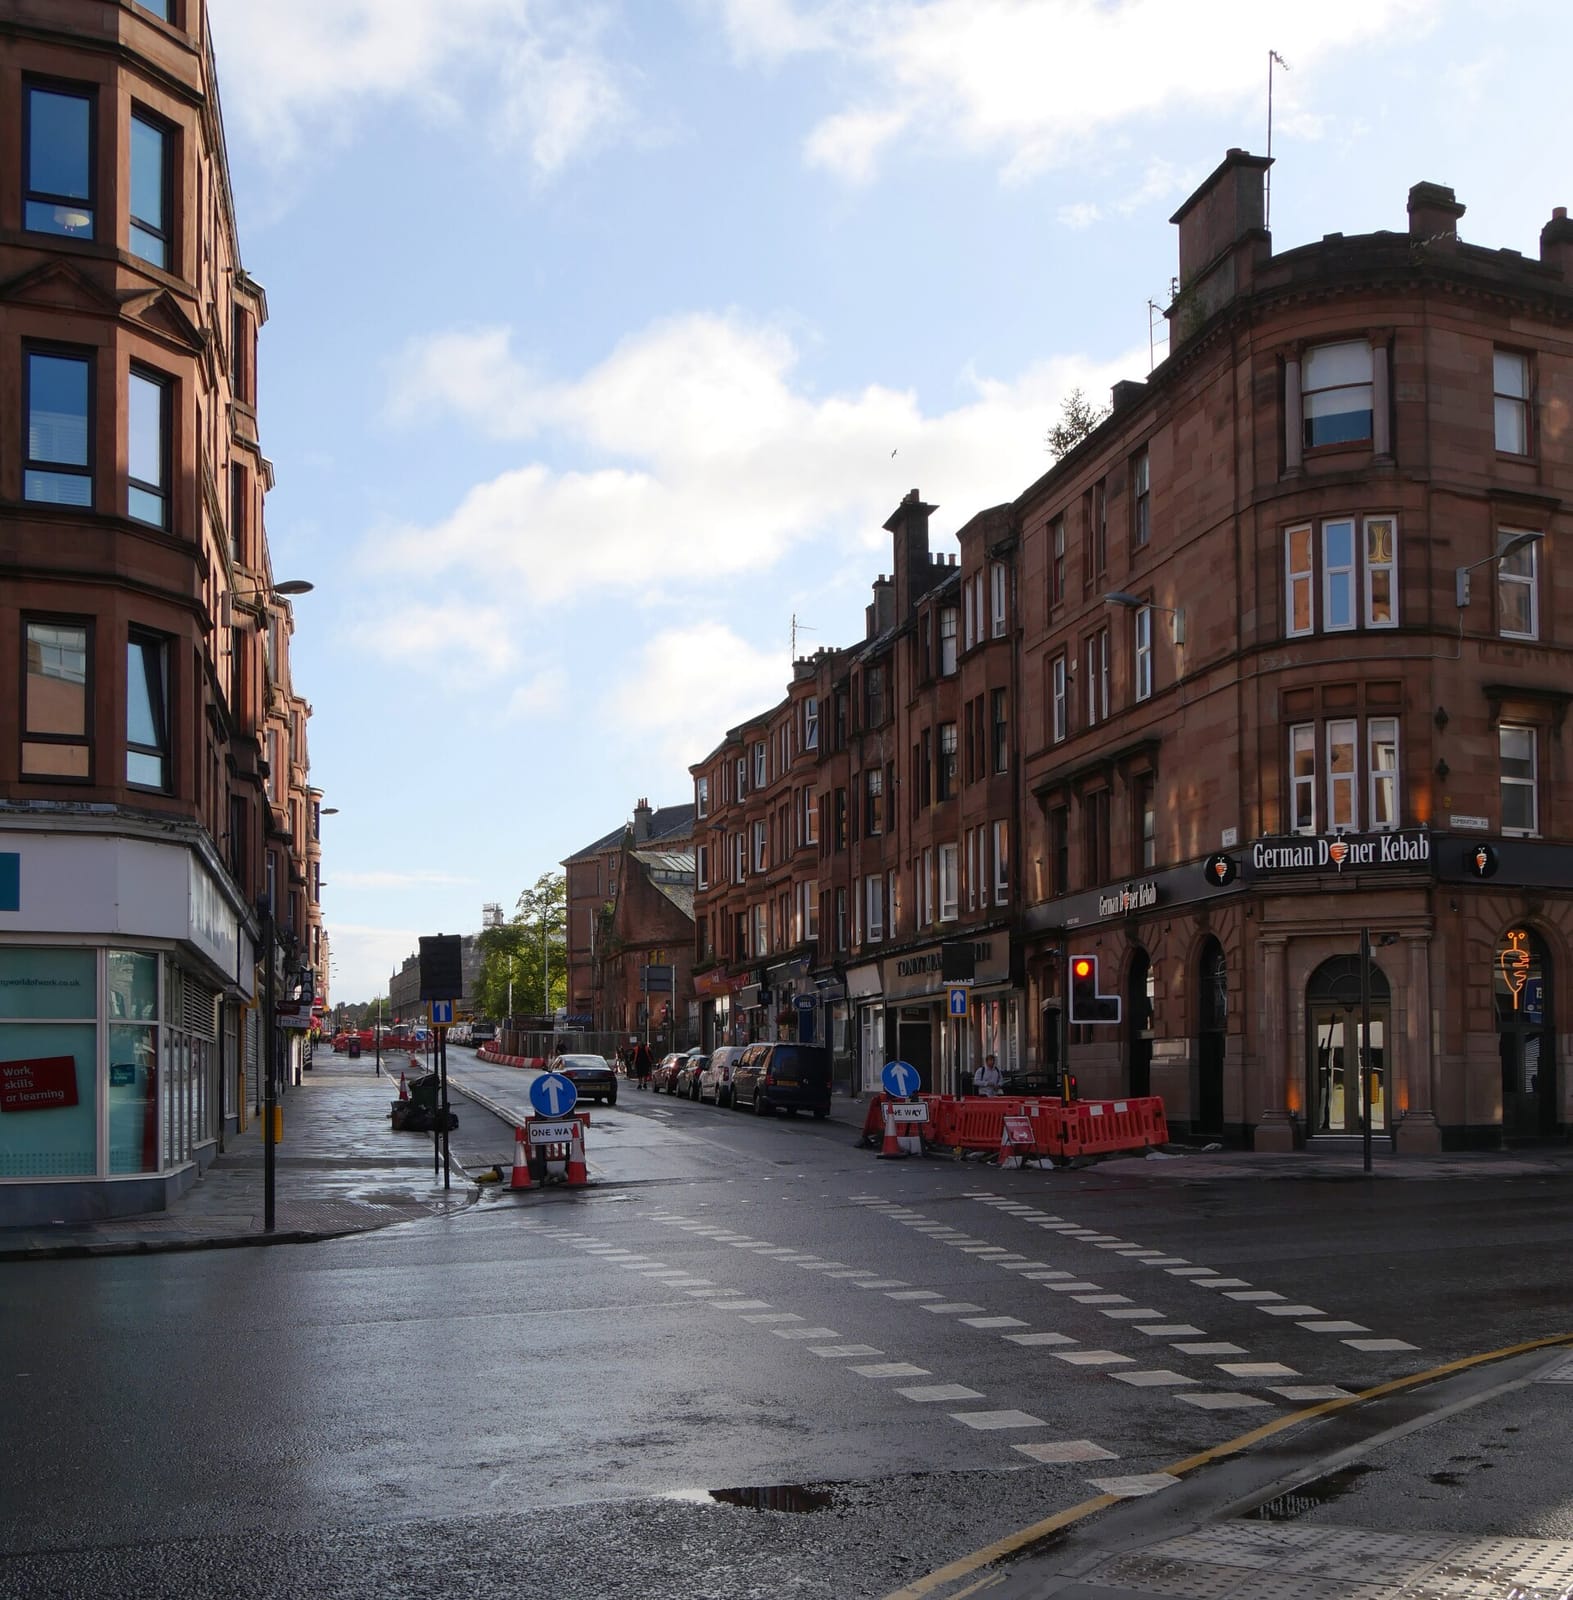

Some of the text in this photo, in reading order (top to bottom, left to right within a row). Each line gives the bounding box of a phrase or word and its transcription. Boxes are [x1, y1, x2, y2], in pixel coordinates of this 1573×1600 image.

[1253, 843, 1314, 869] German
[1380, 833, 1430, 862] Kebab
[1099, 895, 1119, 916] German
[1139, 881, 1157, 907] Kebab
[303, 972, 312, 1001] BAR
[3, 1065, 33, 1076] Work,
[5, 1079, 34, 1089] skills
[6, 1089, 65, 1102] or learning
[904, 1109, 922, 1117] WAY
[531, 1128, 551, 1137] ONE
